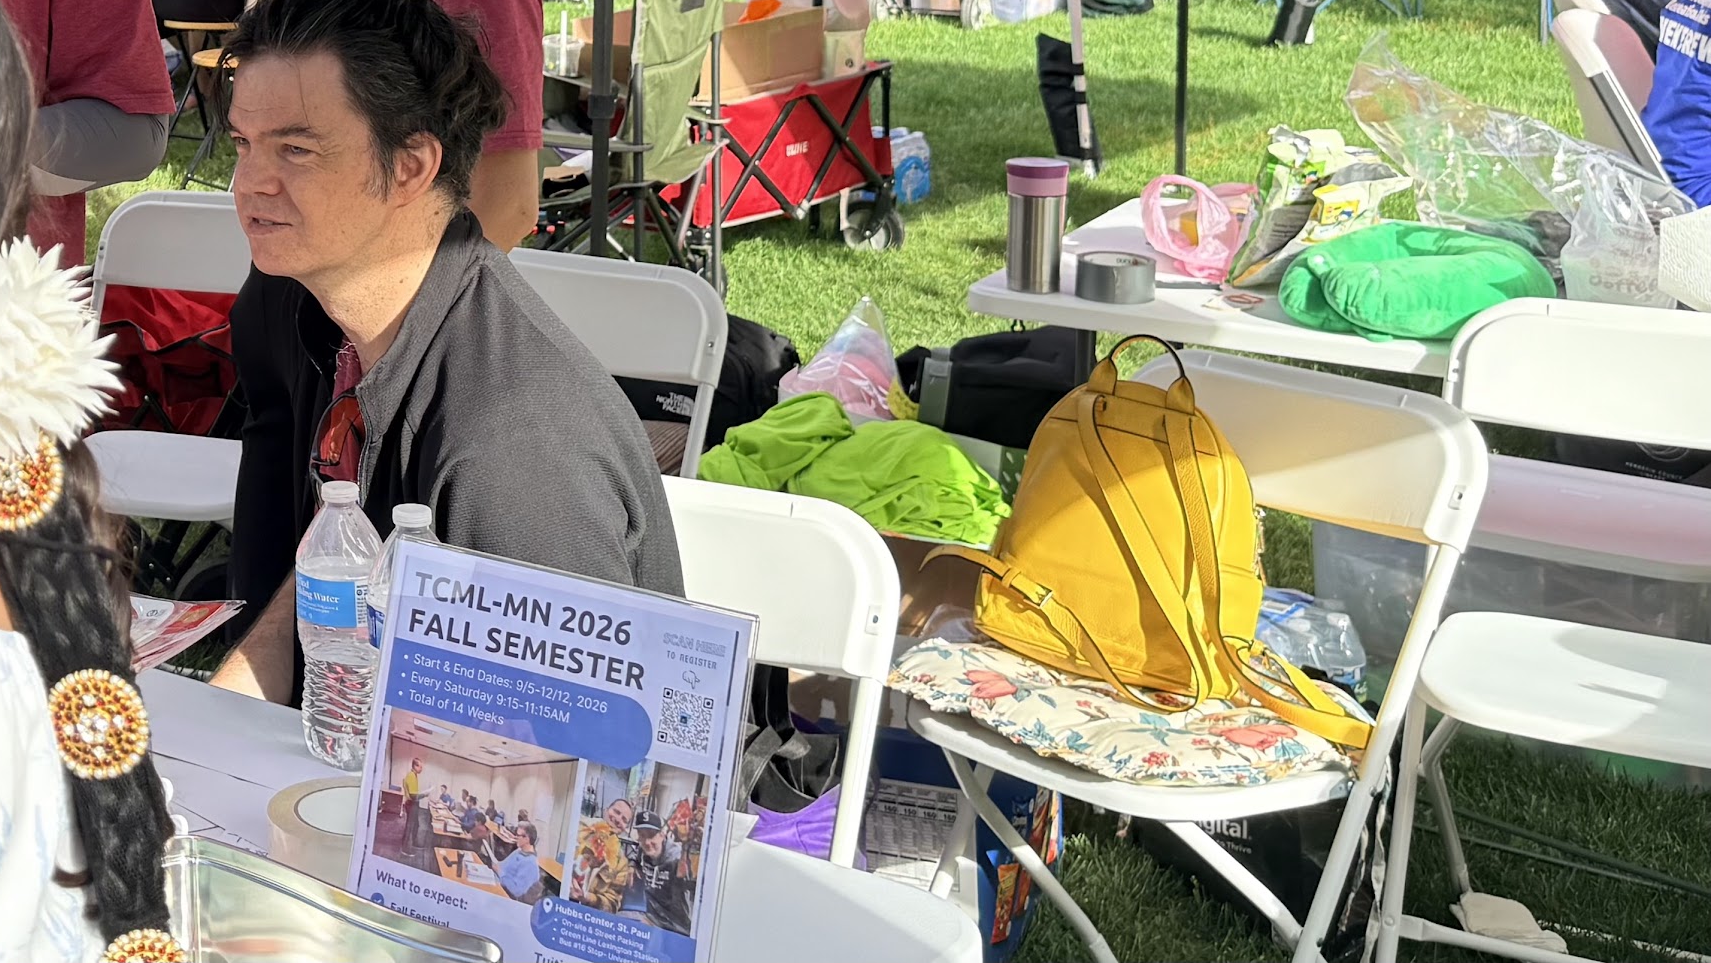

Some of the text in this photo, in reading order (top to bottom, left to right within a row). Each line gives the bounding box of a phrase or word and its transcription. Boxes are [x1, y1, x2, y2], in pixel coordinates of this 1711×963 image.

[313, 592, 340, 604] Water
[415, 570, 553, 628] TCML-MN
[559, 605, 632, 646] 2026
[408, 608, 646, 691] FALL SEMESTER
[667, 650, 717, 670] TO REGISTER
[410, 671, 571, 724] Every Saturday 9:15-11:15AM
[413, 653, 608, 714] Start & End Dates: 9/5-12/12, 2026
[408, 689, 505, 726] Total of 14 Weeks
[1227, 841, 1253, 855] Thrive
[375, 868, 469, 911] What to expect:
[555, 903, 651, 940] Hubbs Center, St. Paul
[561, 918, 644, 951] On-site & Street Parking
[558, 937, 572, 948] Bus
[560, 927, 581, 940] Green
[581, 934, 597, 945] Line
[597, 938, 632, 956] Lexington
